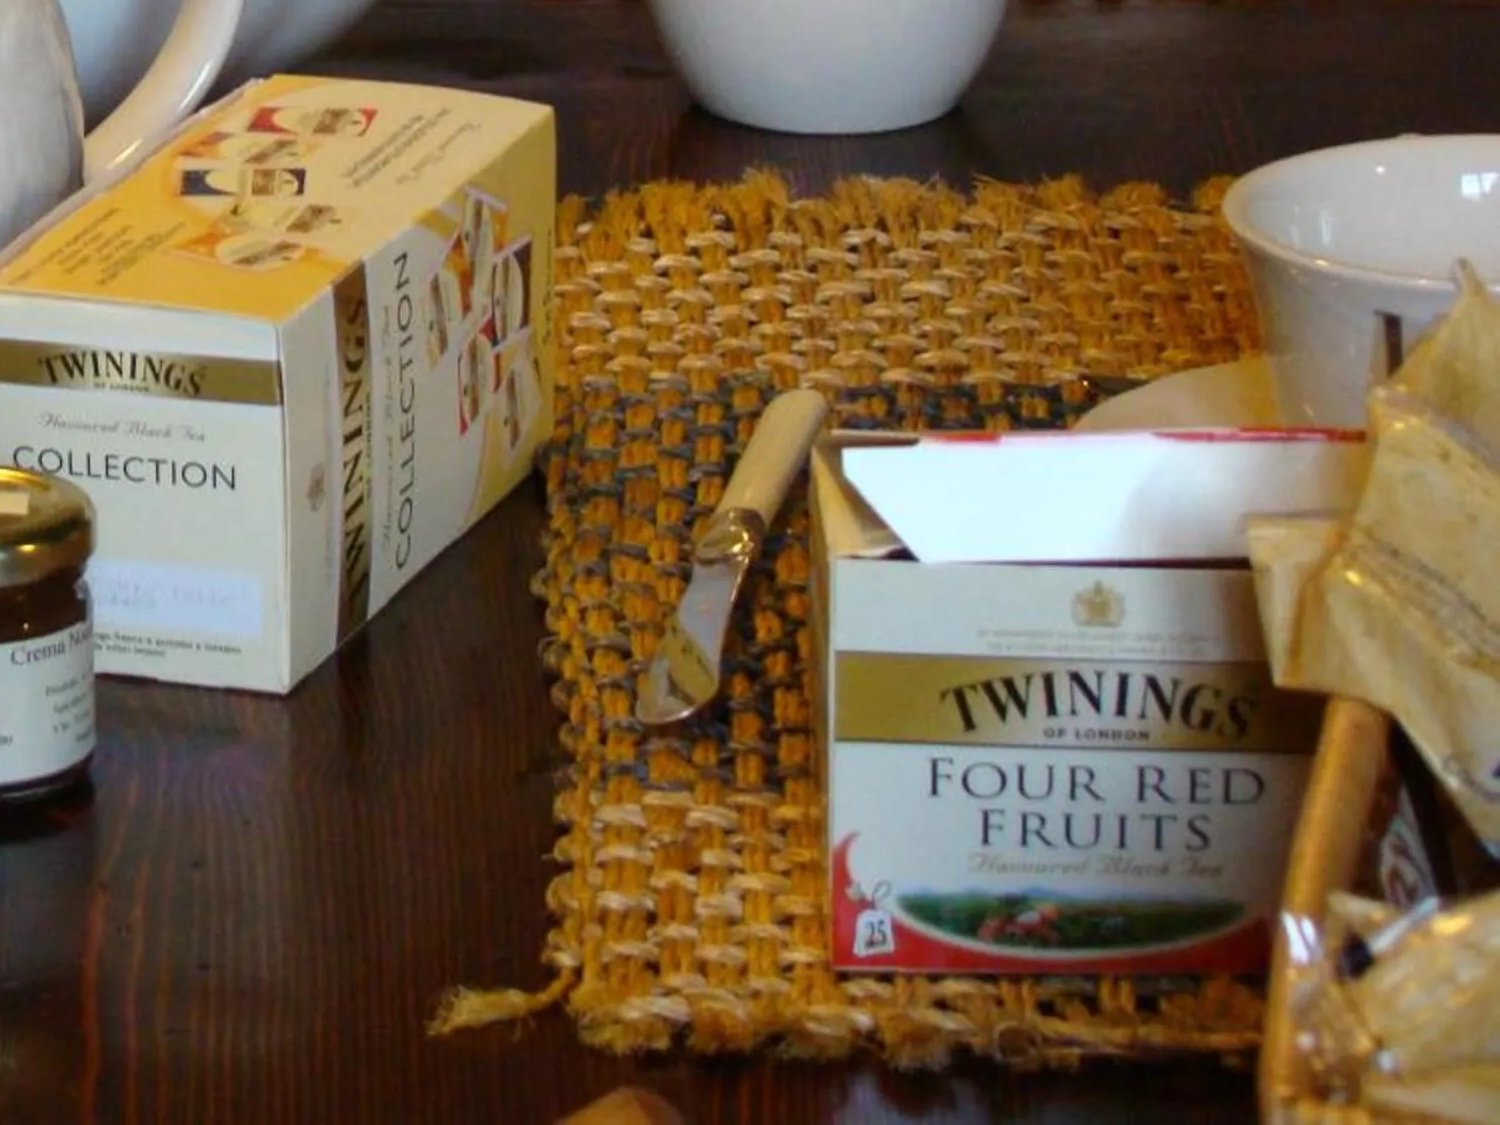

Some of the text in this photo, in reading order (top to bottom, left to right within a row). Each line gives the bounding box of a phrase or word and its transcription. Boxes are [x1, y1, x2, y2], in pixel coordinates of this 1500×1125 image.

[37, 349, 208, 398] TWININGS
[393, 251, 416, 571] COLLECTION
[13, 445, 237, 492] COLLECTION
[341, 296, 371, 617] TWININGS
[11, 641, 66, 666] Crema
[940, 668, 1262, 740] TWININGS
[1043, 727, 1151, 742] OF LONDON
[927, 756, 1267, 806] FOUR RED
[980, 808, 1213, 853] FRUITS
[864, 918, 888, 949] 25
